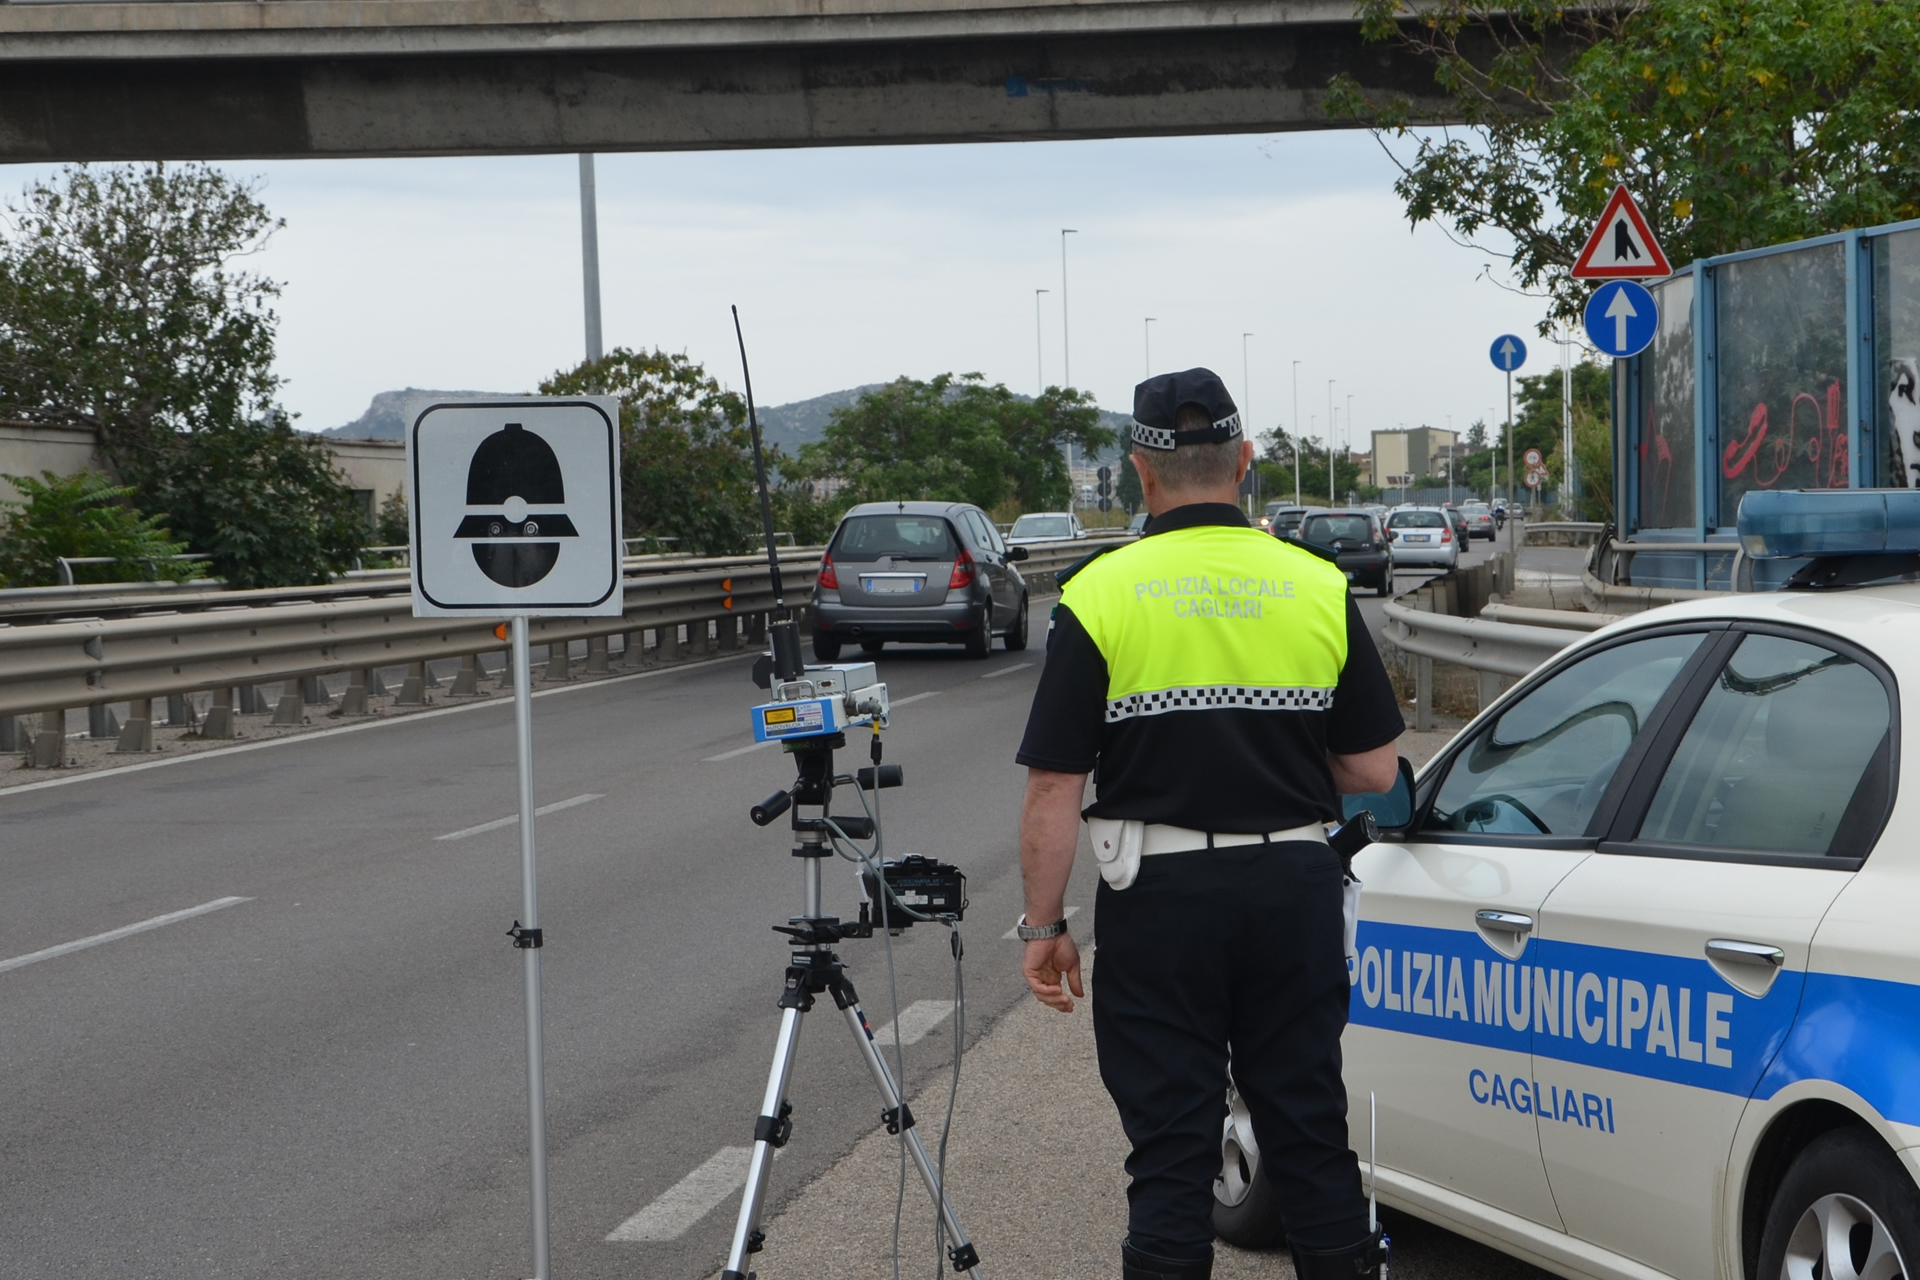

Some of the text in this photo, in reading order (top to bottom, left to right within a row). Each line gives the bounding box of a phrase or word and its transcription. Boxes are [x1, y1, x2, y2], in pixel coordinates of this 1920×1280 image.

[1134, 576, 1296, 600] POLIZIA LOCALE
[1174, 598, 1263, 619] CAGLIARI
[1473, 959, 1734, 1069] MUNICIPALE
[1468, 1068, 1616, 1134] CAGLIARI
